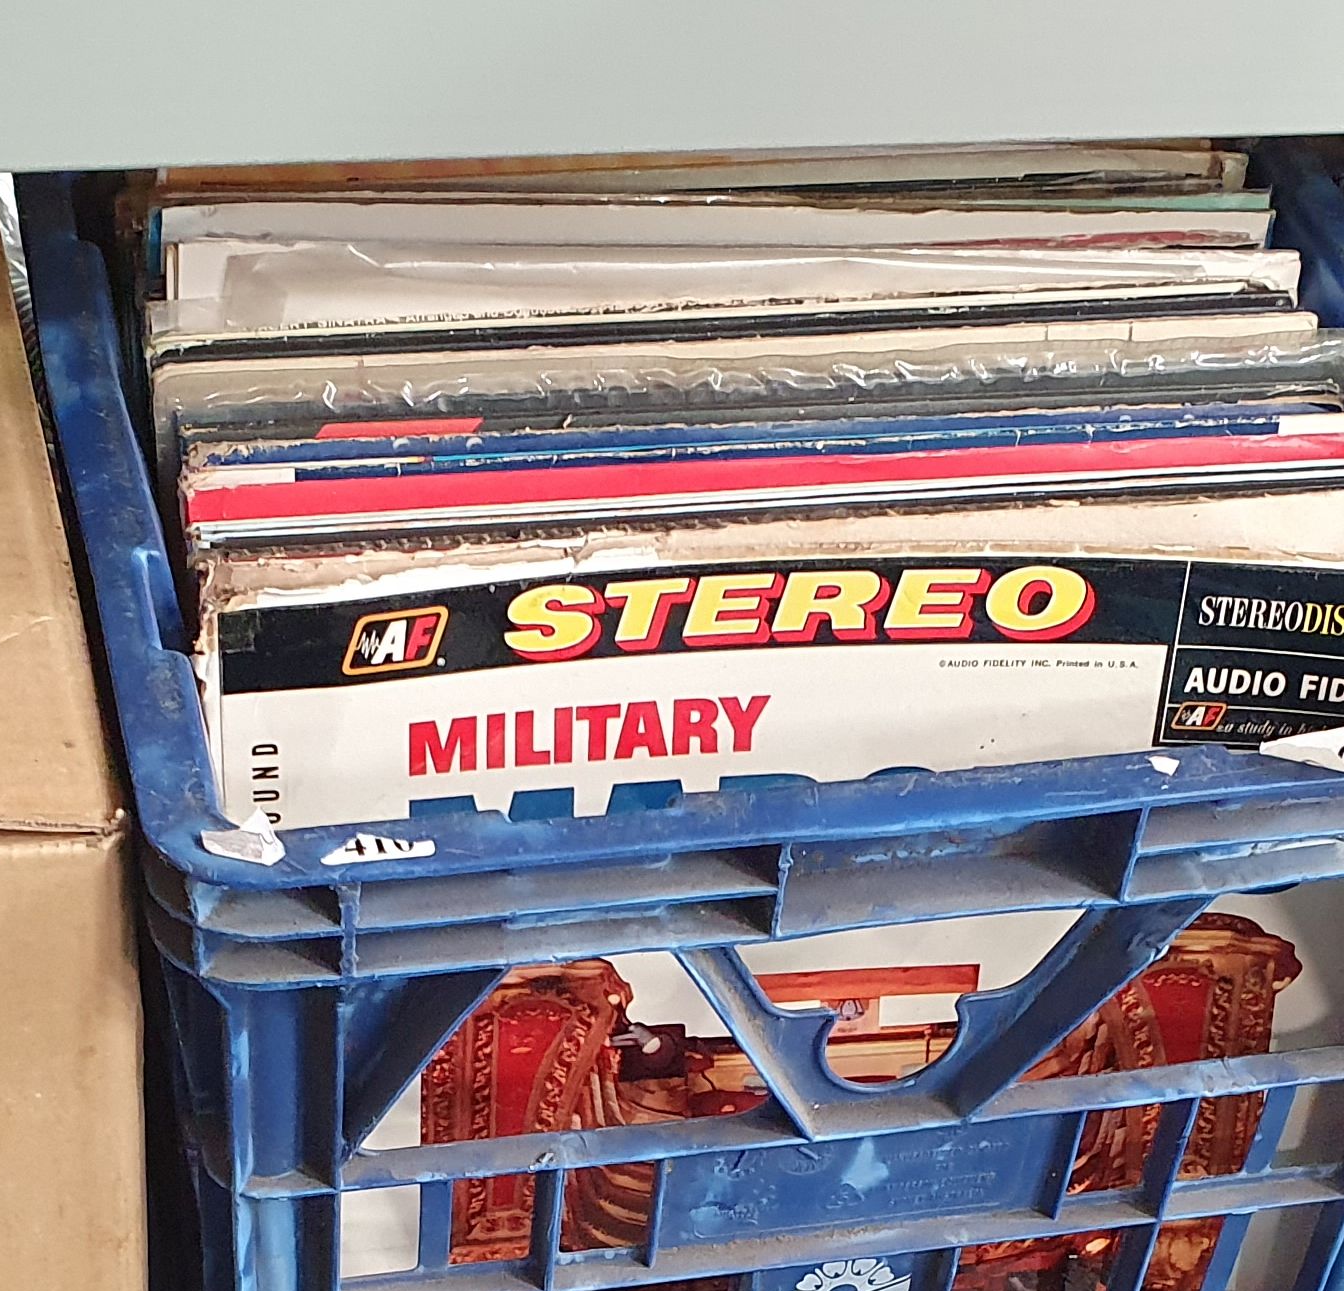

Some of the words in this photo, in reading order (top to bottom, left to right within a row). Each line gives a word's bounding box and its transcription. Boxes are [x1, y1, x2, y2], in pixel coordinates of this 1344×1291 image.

[504, 565, 1096, 661] STEREO
[983, 659, 1027, 668] FIDELITY
[1031, 659, 1051, 668] INC.
[1056, 659, 1090, 669] Printed
[1184, 667, 1286, 697] AUDIO
[409, 695, 771, 777] MILITARY
[1237, 720, 1275, 738] study
[1278, 723, 1293, 734] in
